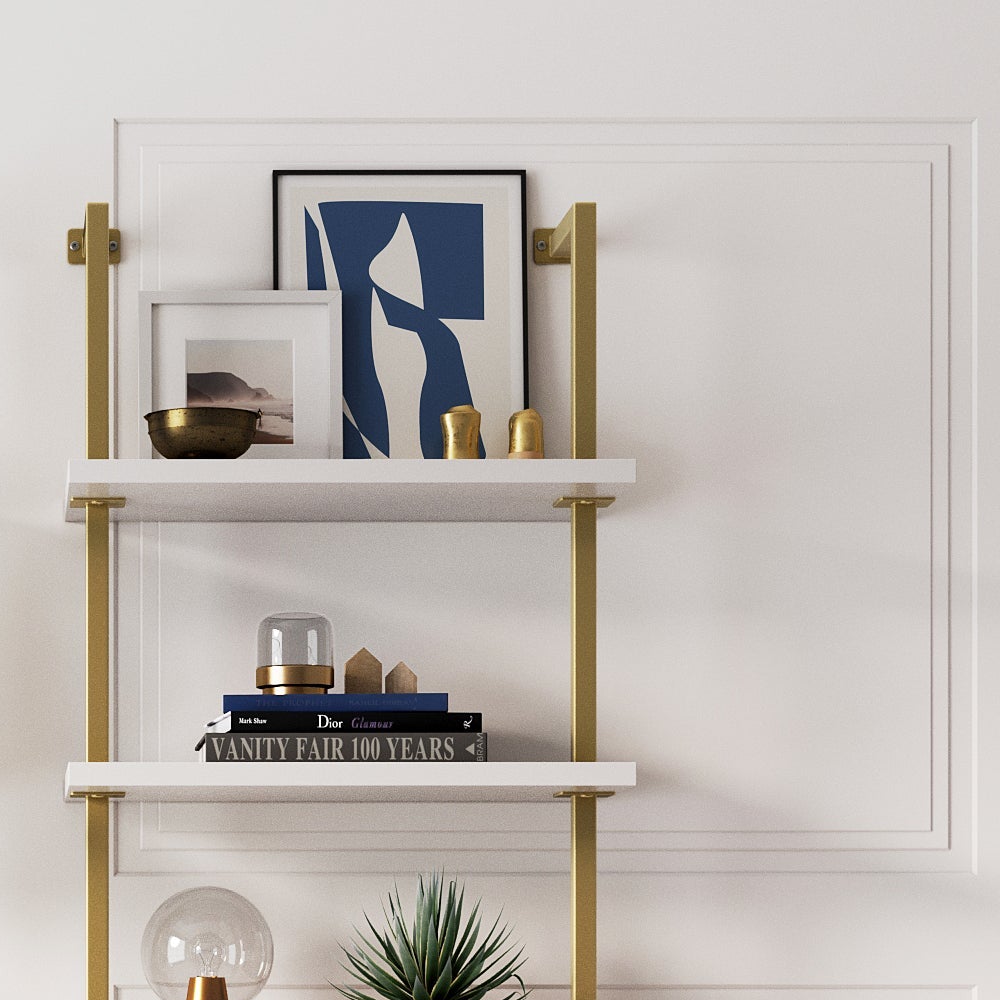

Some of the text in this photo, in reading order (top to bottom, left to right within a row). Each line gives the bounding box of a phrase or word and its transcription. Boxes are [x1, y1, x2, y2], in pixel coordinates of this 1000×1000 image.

[317, 714, 394, 729] Dior Glamour
[211, 736, 455, 760] VANITY FAIR 100 YEARS
